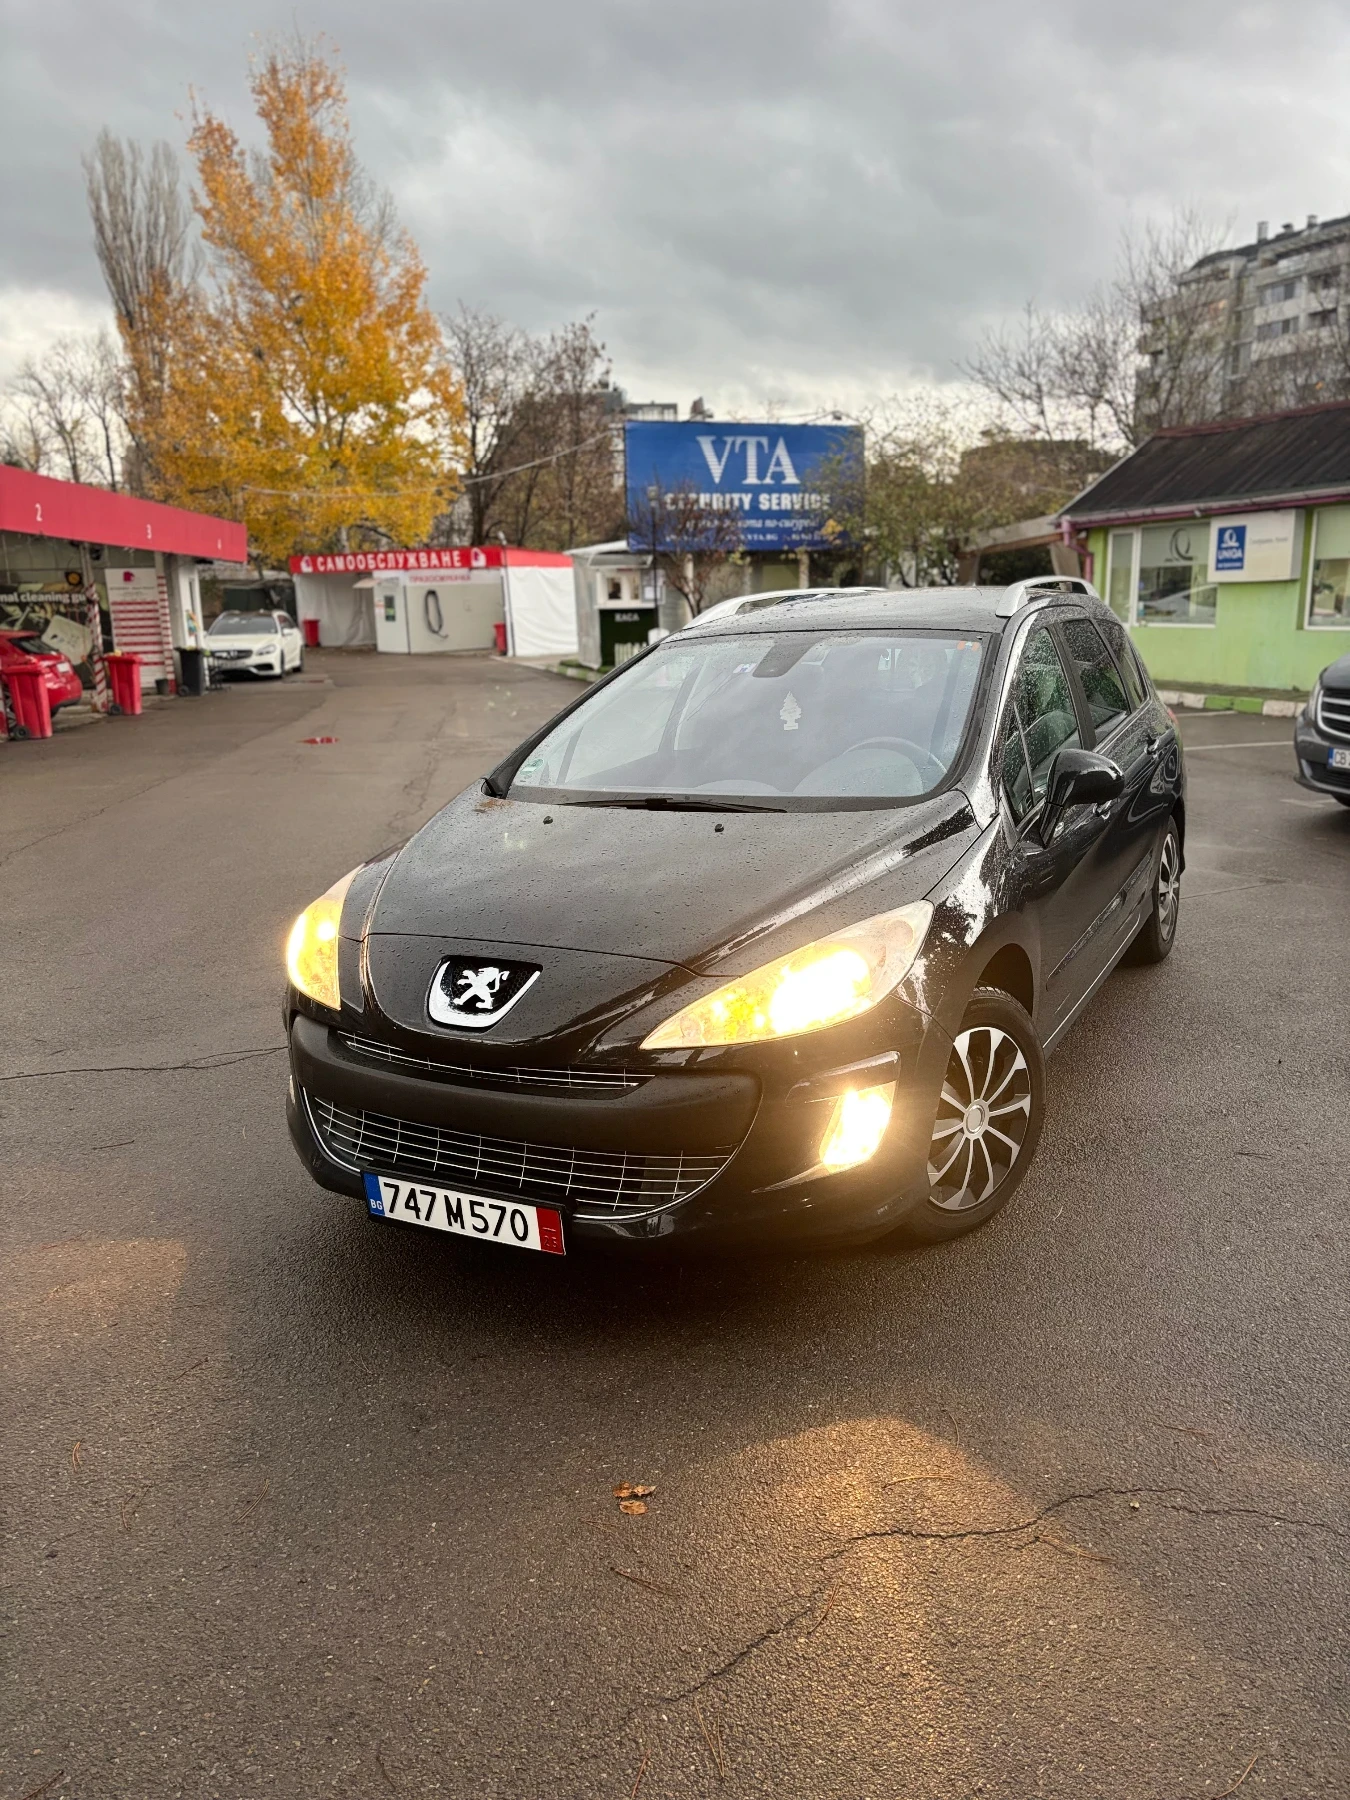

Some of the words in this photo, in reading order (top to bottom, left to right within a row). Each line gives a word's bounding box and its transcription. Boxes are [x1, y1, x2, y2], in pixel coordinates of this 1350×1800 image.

[696, 436, 801, 484] VTA
[758, 493, 831, 511] SERVICE
[35, 503, 42, 521] 2
[146, 524, 152, 539] 3
[317, 550, 462, 572] САМООБСЛУЖВАНЕ
[0, 592, 19, 602] nal
[20, 592, 70, 604] cleaning
[370, 1200, 383, 1211] BG
